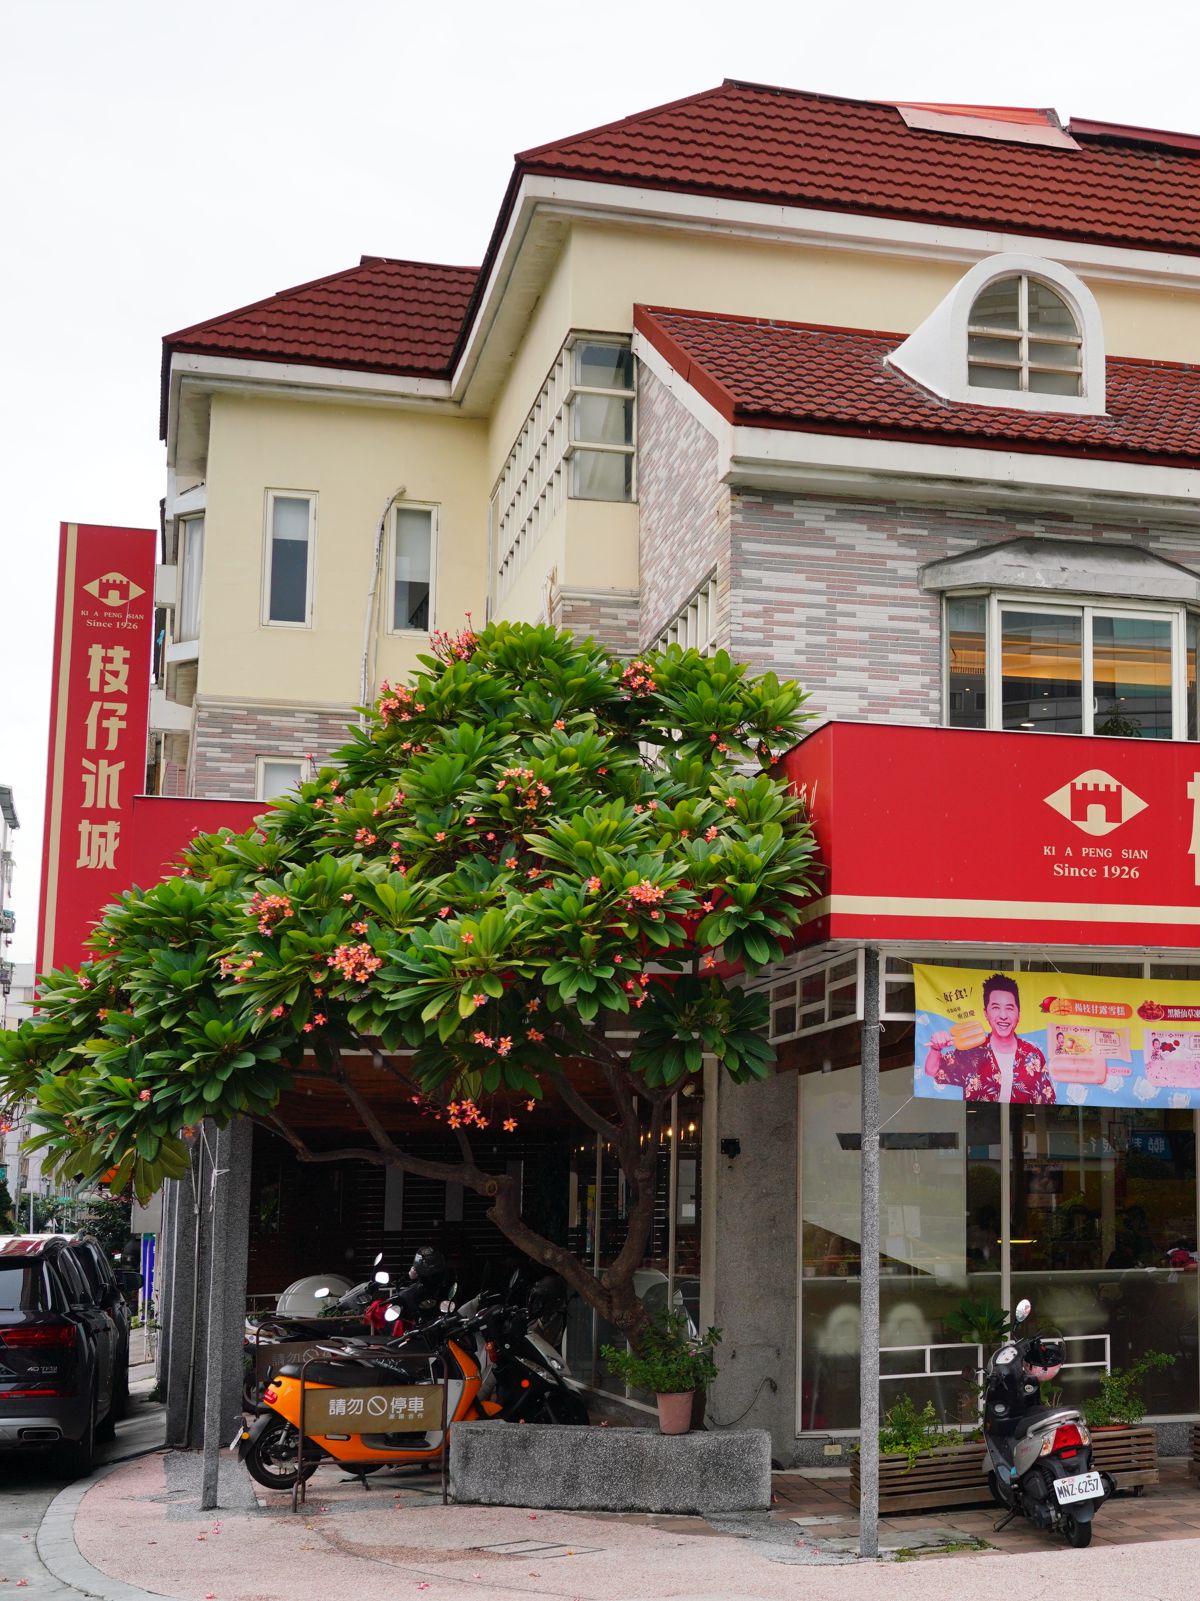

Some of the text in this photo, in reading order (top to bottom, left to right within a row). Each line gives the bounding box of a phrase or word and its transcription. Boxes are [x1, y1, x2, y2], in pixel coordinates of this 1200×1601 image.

[86, 619, 138, 630] Since 1926
[1043, 846, 1148, 859] KI A PENG SIAN
[1053, 863, 1140, 879] Since 1926
[329, 1396, 425, 1416] 請勿 停車
[1057, 1478, 1099, 1499] MNZ-6257
